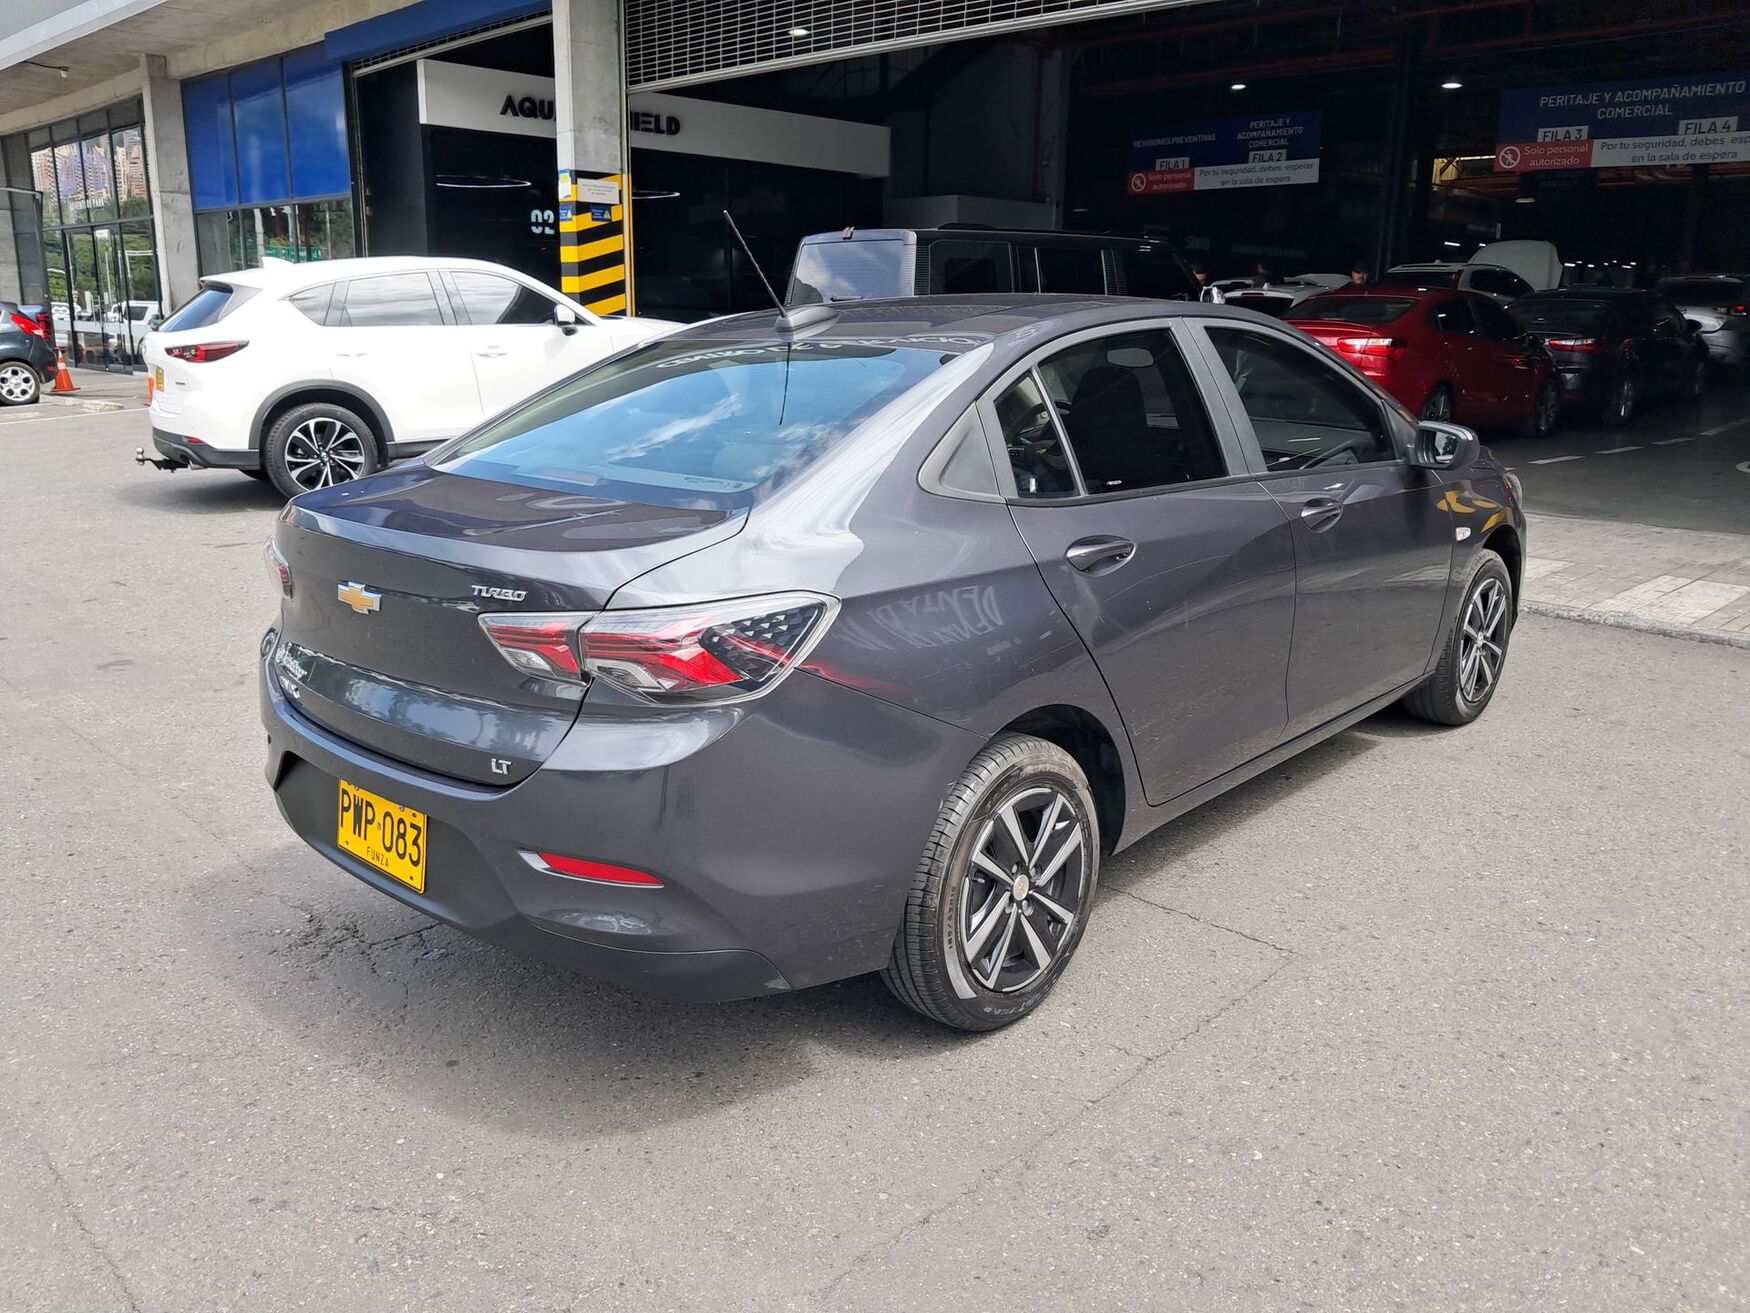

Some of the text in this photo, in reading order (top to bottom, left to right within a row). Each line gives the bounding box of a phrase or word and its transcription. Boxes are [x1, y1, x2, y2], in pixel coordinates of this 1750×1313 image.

[1540, 81, 1746, 108] PERITAJE Y ACOMPAÑAMIENTO
[500, 95, 557, 120] AQU
[1597, 104, 1673, 120] COMERCIAL
[1249, 117, 1292, 129] PERITAJE Y
[1684, 120, 1732, 135] FILA 4
[1248, 137, 1290, 149] COMERCIAL
[1543, 129, 1584, 142] FILA 3
[1524, 144, 1588, 156] Solo personal
[1600, 141, 1619, 151] Por
[1620, 141, 1630, 150] tu
[1631, 138, 1688, 152] seguridad,
[1690, 136, 1726, 147] debes
[1252, 151, 1283, 164] FILA 2
[1529, 156, 1580, 167] autorizado
[1631, 150, 1738, 163] en la sala de espera
[1160, 160, 1179, 170] FILA
[530, 208, 556, 235] 02
[471, 585, 528, 602] TURBO
[491, 758, 512, 775] LT
[366, 846, 390, 867] FUNZA
